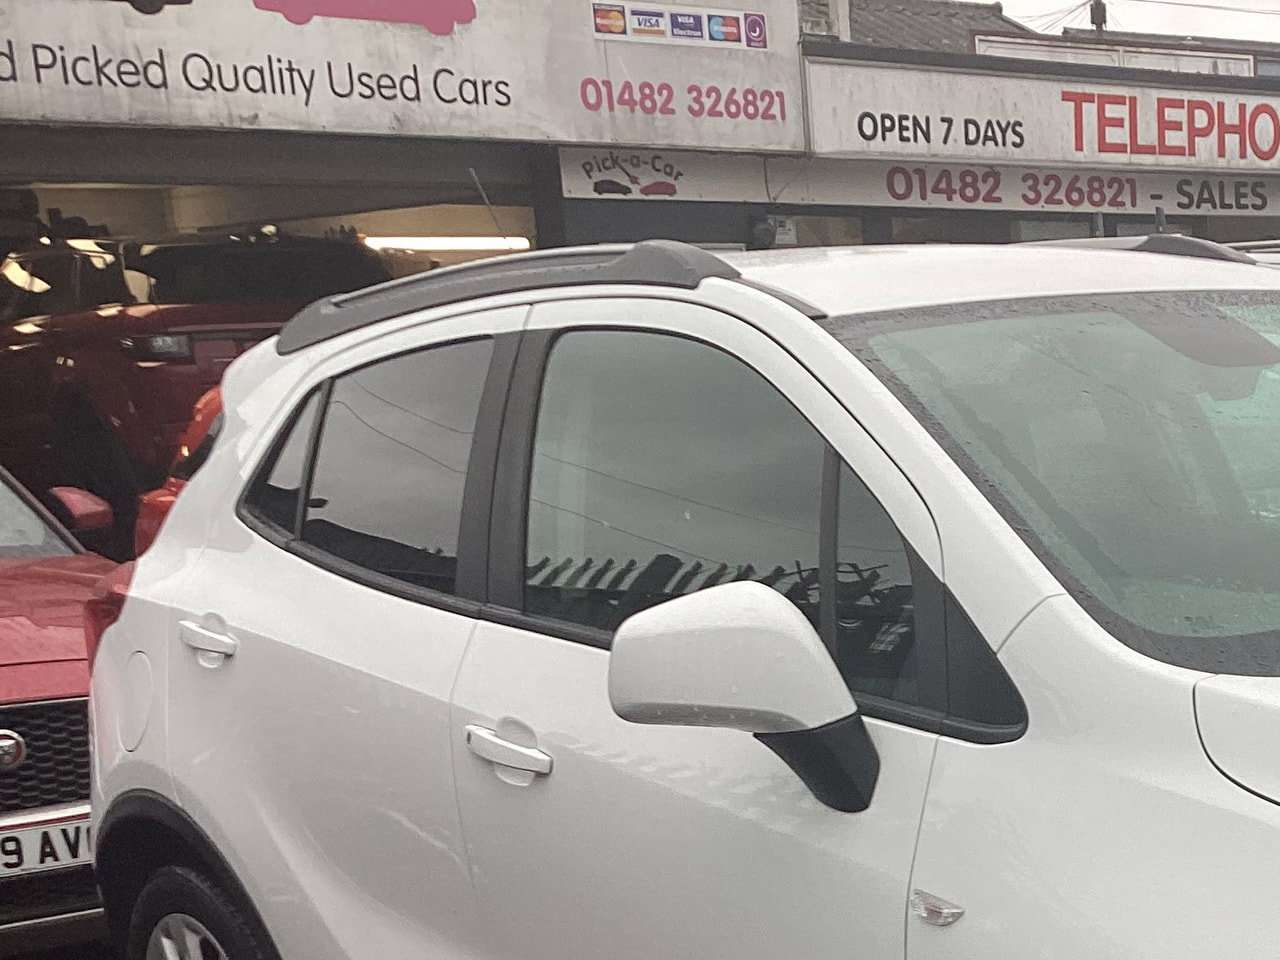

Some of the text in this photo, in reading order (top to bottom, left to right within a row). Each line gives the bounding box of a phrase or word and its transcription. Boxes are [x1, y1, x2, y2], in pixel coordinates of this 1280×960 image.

[636, 17, 660, 28] VISA
[32, 43, 168, 90] Picked
[183, 53, 315, 107] Quality
[327, 61, 421, 103] Used
[433, 68, 511, 107] Cars
[580, 77, 786, 121] 01482 326821
[857, 111, 1025, 149] OPEN 7 DAYS
[886, 166, 1002, 203] 01482
[1021, 172, 1137, 208] 326821
[1176, 178, 1268, 211] SALES
